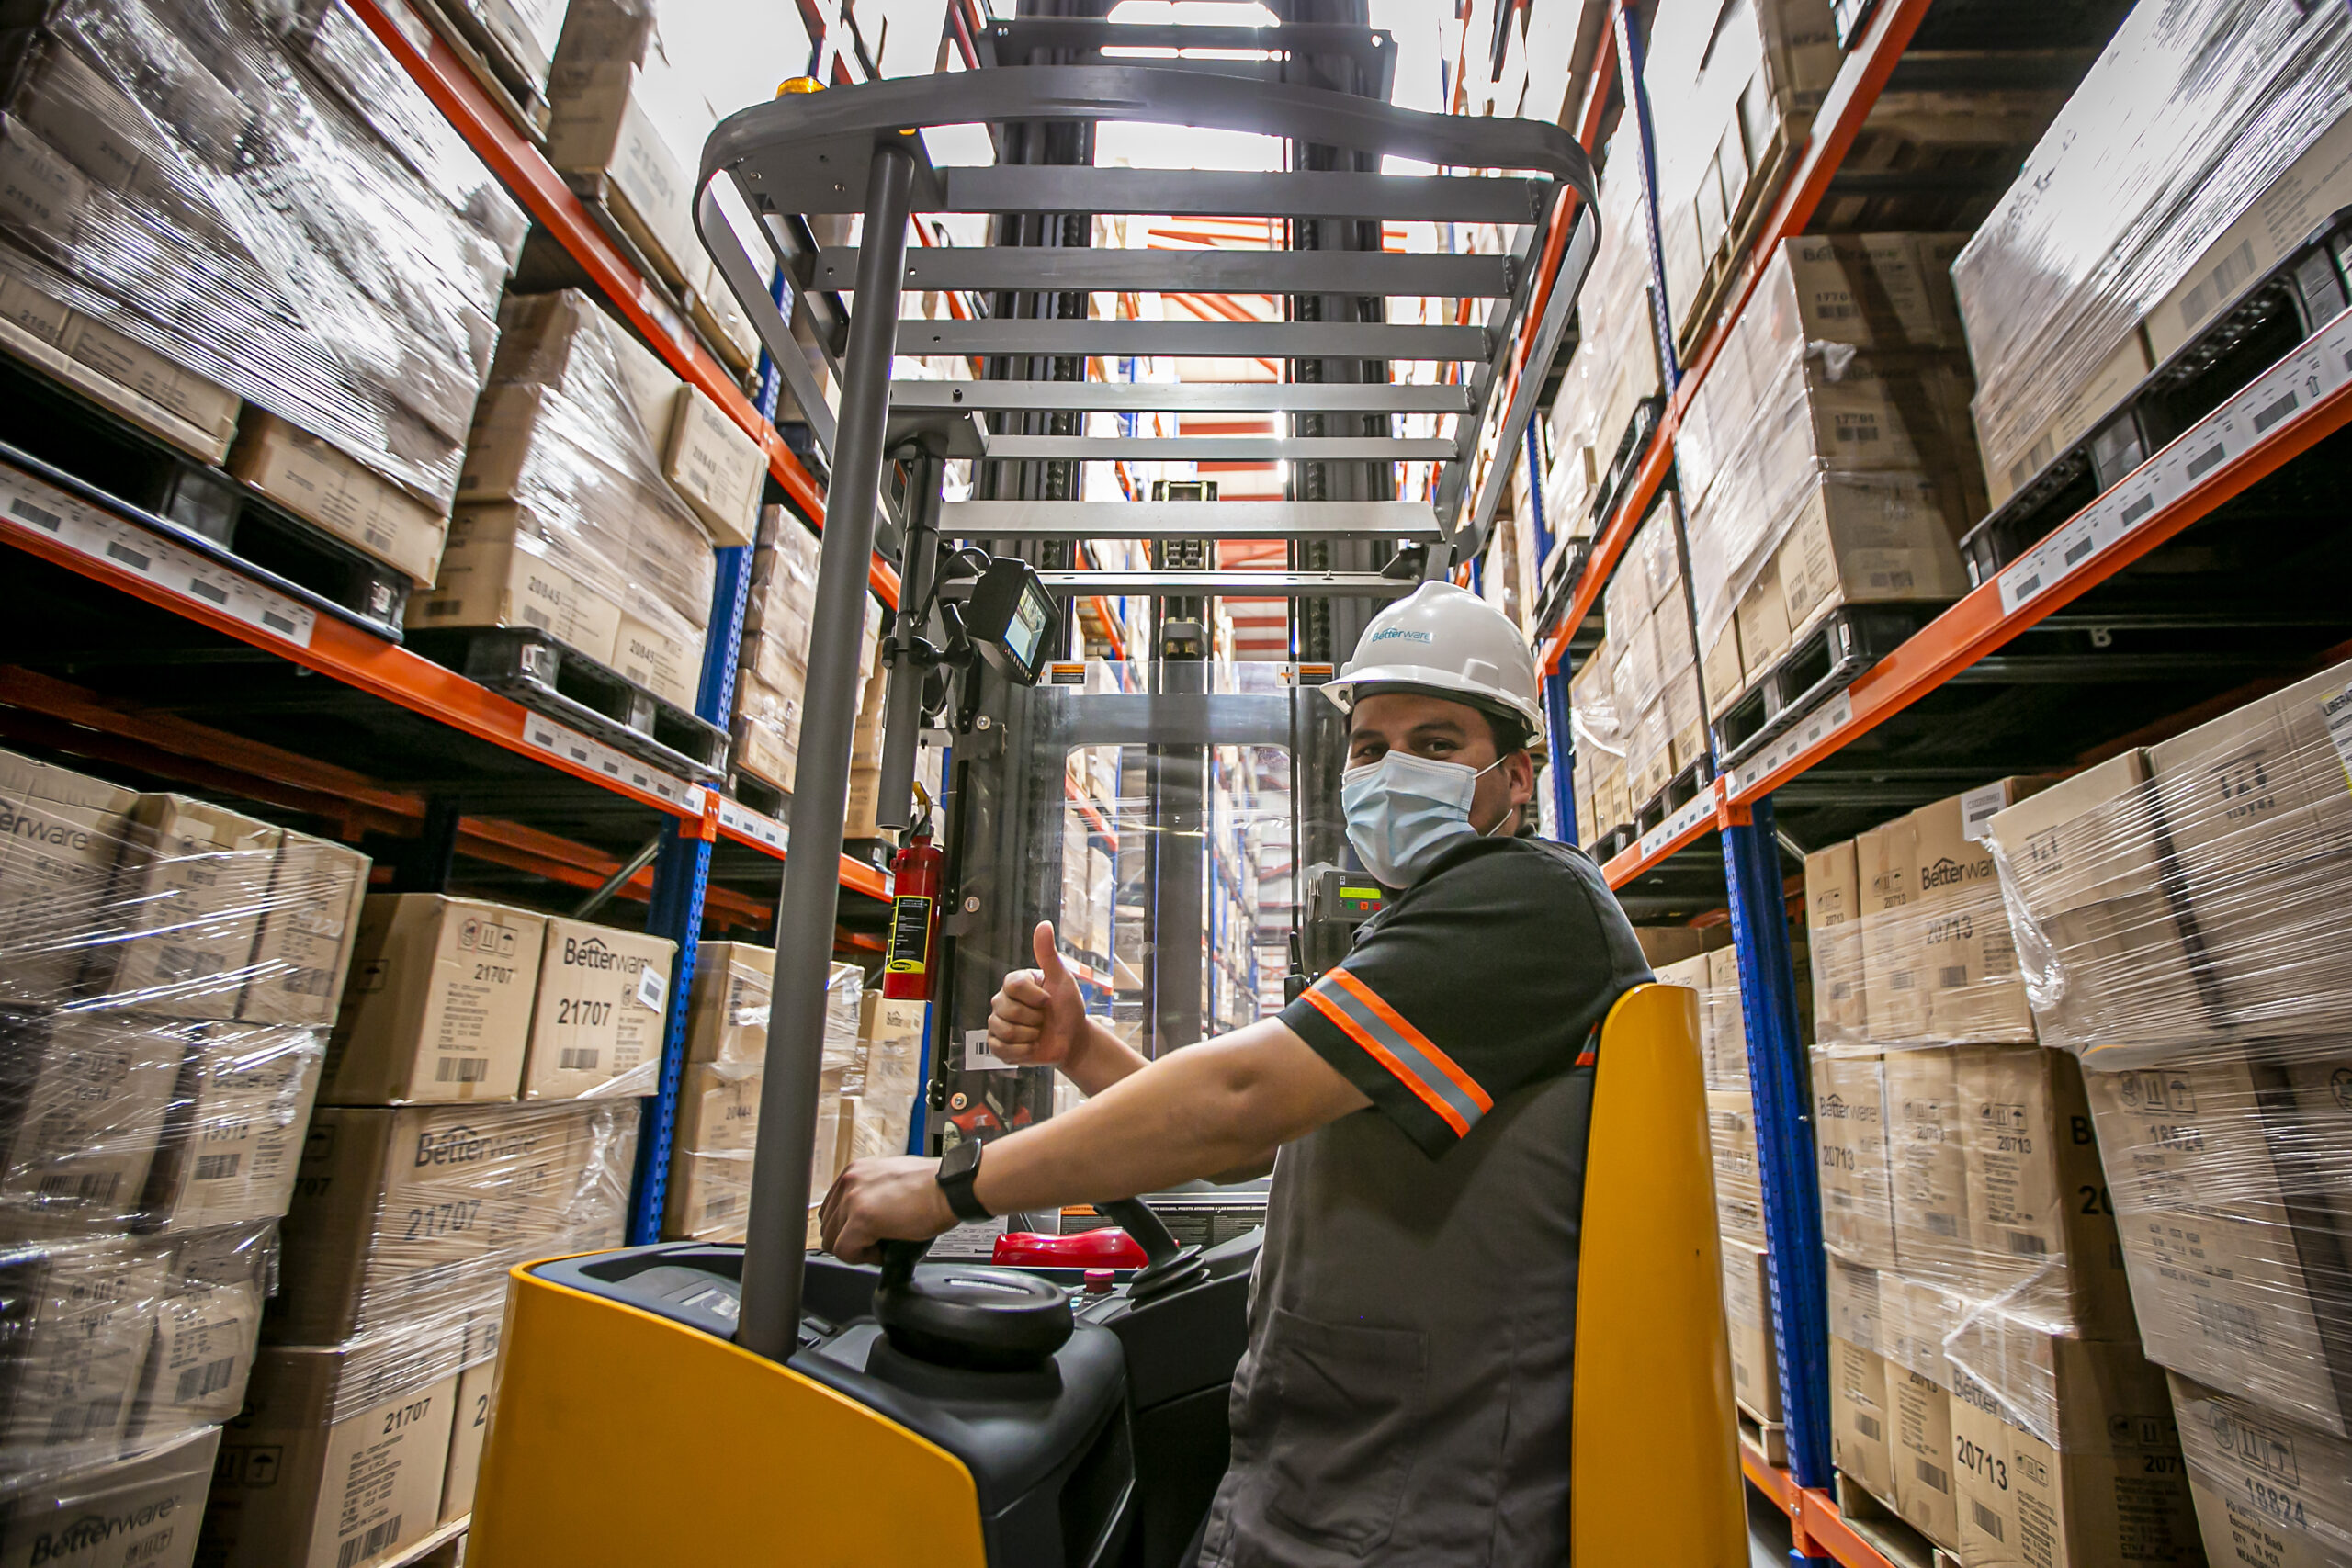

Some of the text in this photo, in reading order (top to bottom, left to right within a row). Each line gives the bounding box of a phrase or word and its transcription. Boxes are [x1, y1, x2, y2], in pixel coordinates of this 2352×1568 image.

[1373, 628, 1431, 642] Betterware
[1922, 857, 1996, 890] Betterwar
[1927, 915, 1973, 945] 20713
[474, 963, 515, 985] 21707
[557, 998, 613, 1027] 21707
[414, 1125, 536, 1168] Betterware
[1823, 1145, 1855, 1170] 20713
[1997, 1135, 2032, 1154] 20713
[294, 1178, 333, 1197] 707
[404, 1199, 482, 1241] 21707
[382, 1396, 432, 1435] 21707
[1956, 1434, 2008, 1492] 20713
[2143, 1454, 2187, 1474] 2071
[2245, 1476, 2308, 1530] 18824
[30, 1496, 176, 1567] Betterware
